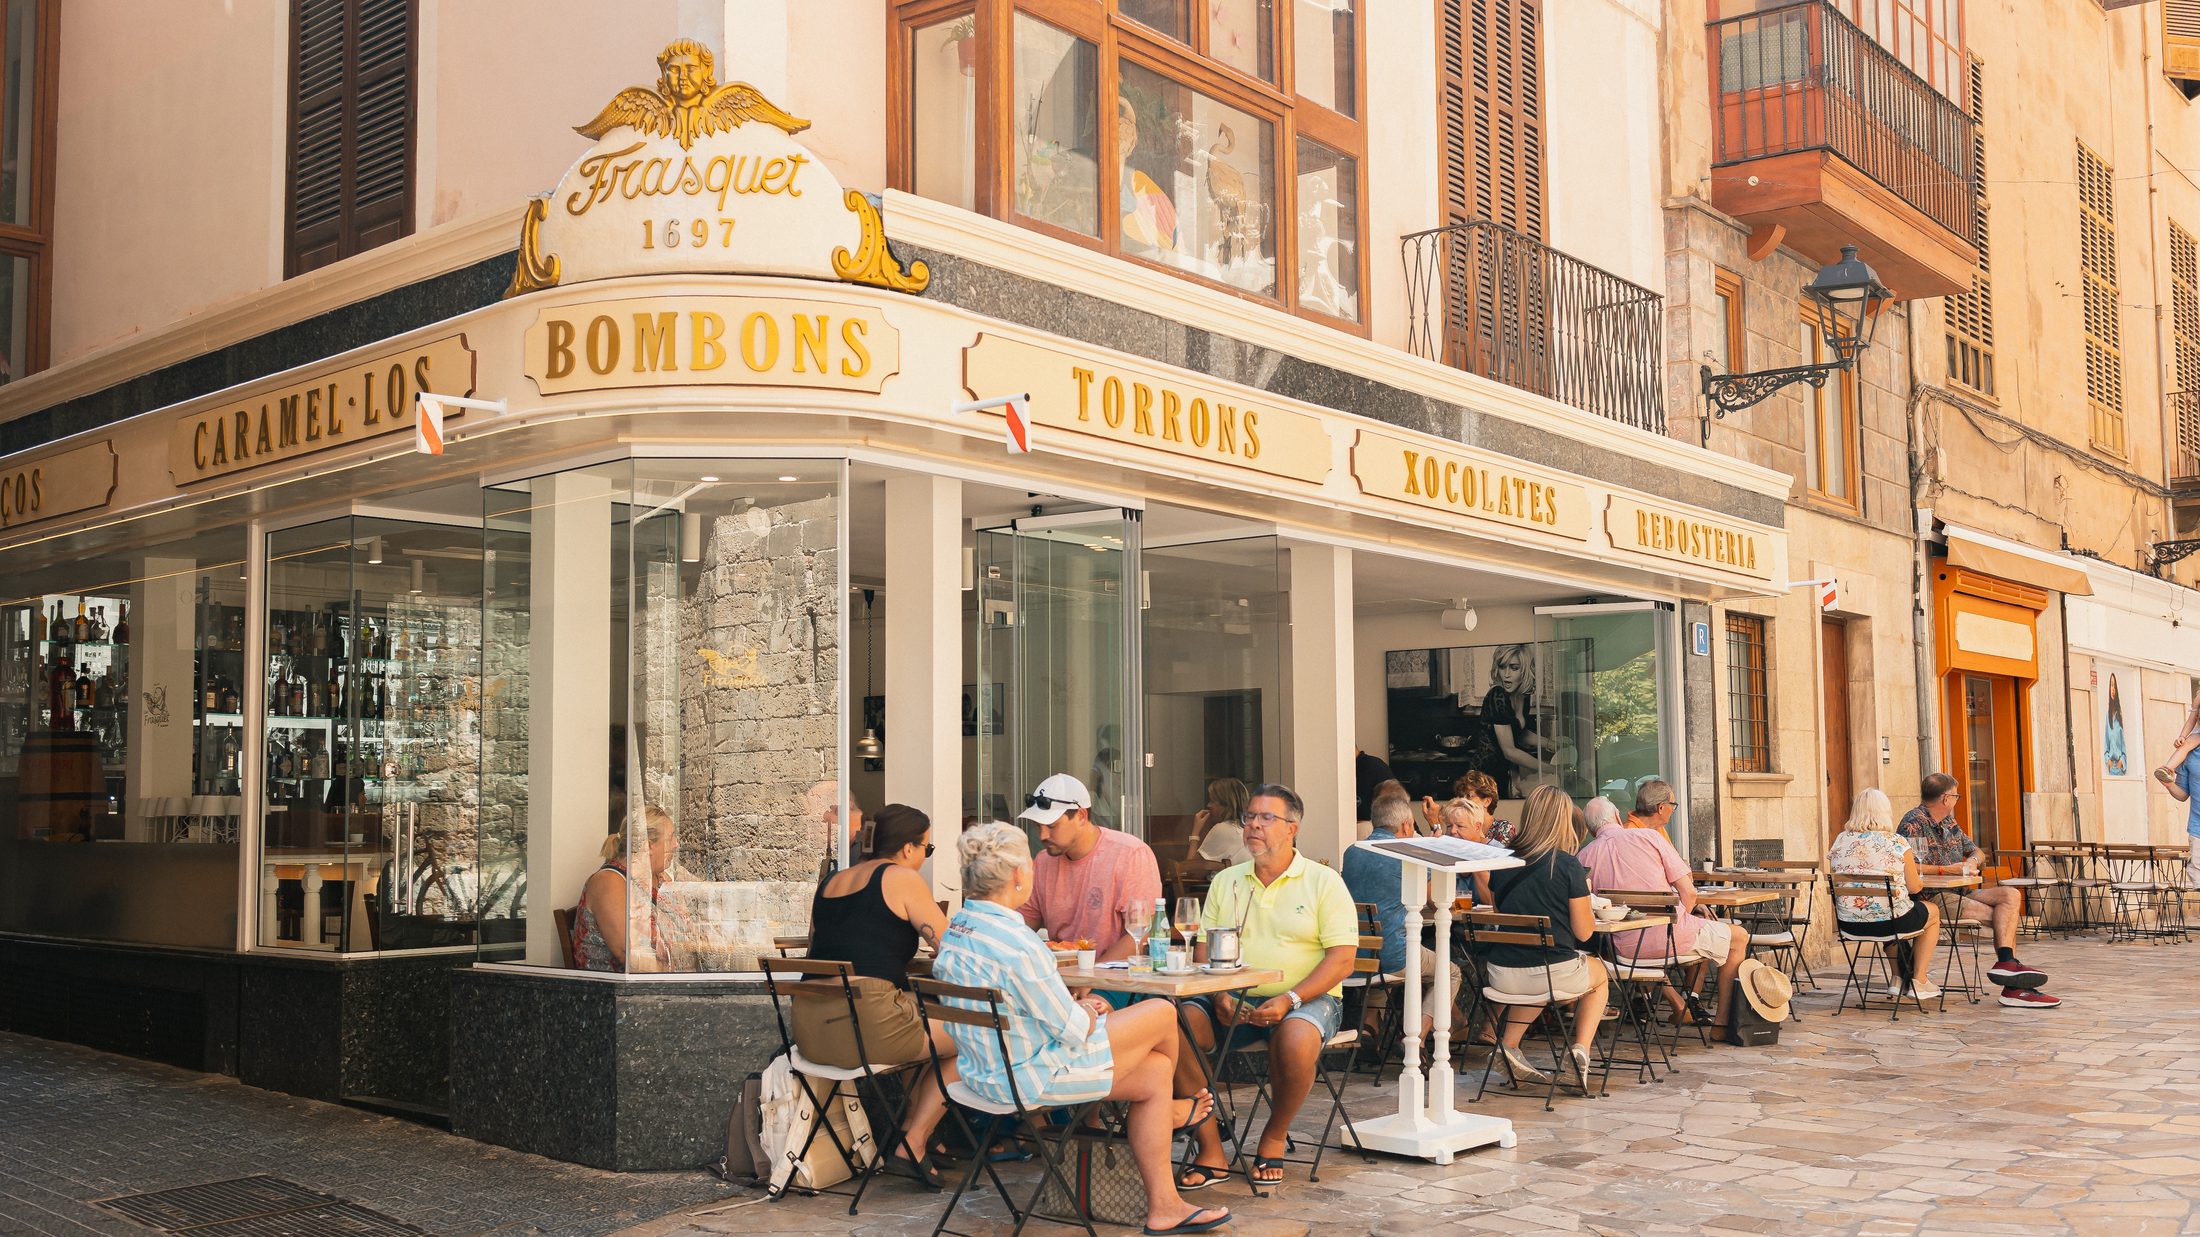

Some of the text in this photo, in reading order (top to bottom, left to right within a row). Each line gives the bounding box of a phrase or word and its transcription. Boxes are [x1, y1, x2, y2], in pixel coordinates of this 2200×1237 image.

[567, 141, 810, 216] Frasquet
[642, 218, 736, 249] 1697
[545, 311, 871, 379] BOMBONS
[1073, 366, 1261, 459] TORRONS
[1403, 450, 1558, 526] XOCOLATES
[1636, 509, 1757, 570] REBOSTERIA
[1699, 628, 1705, 645] R
